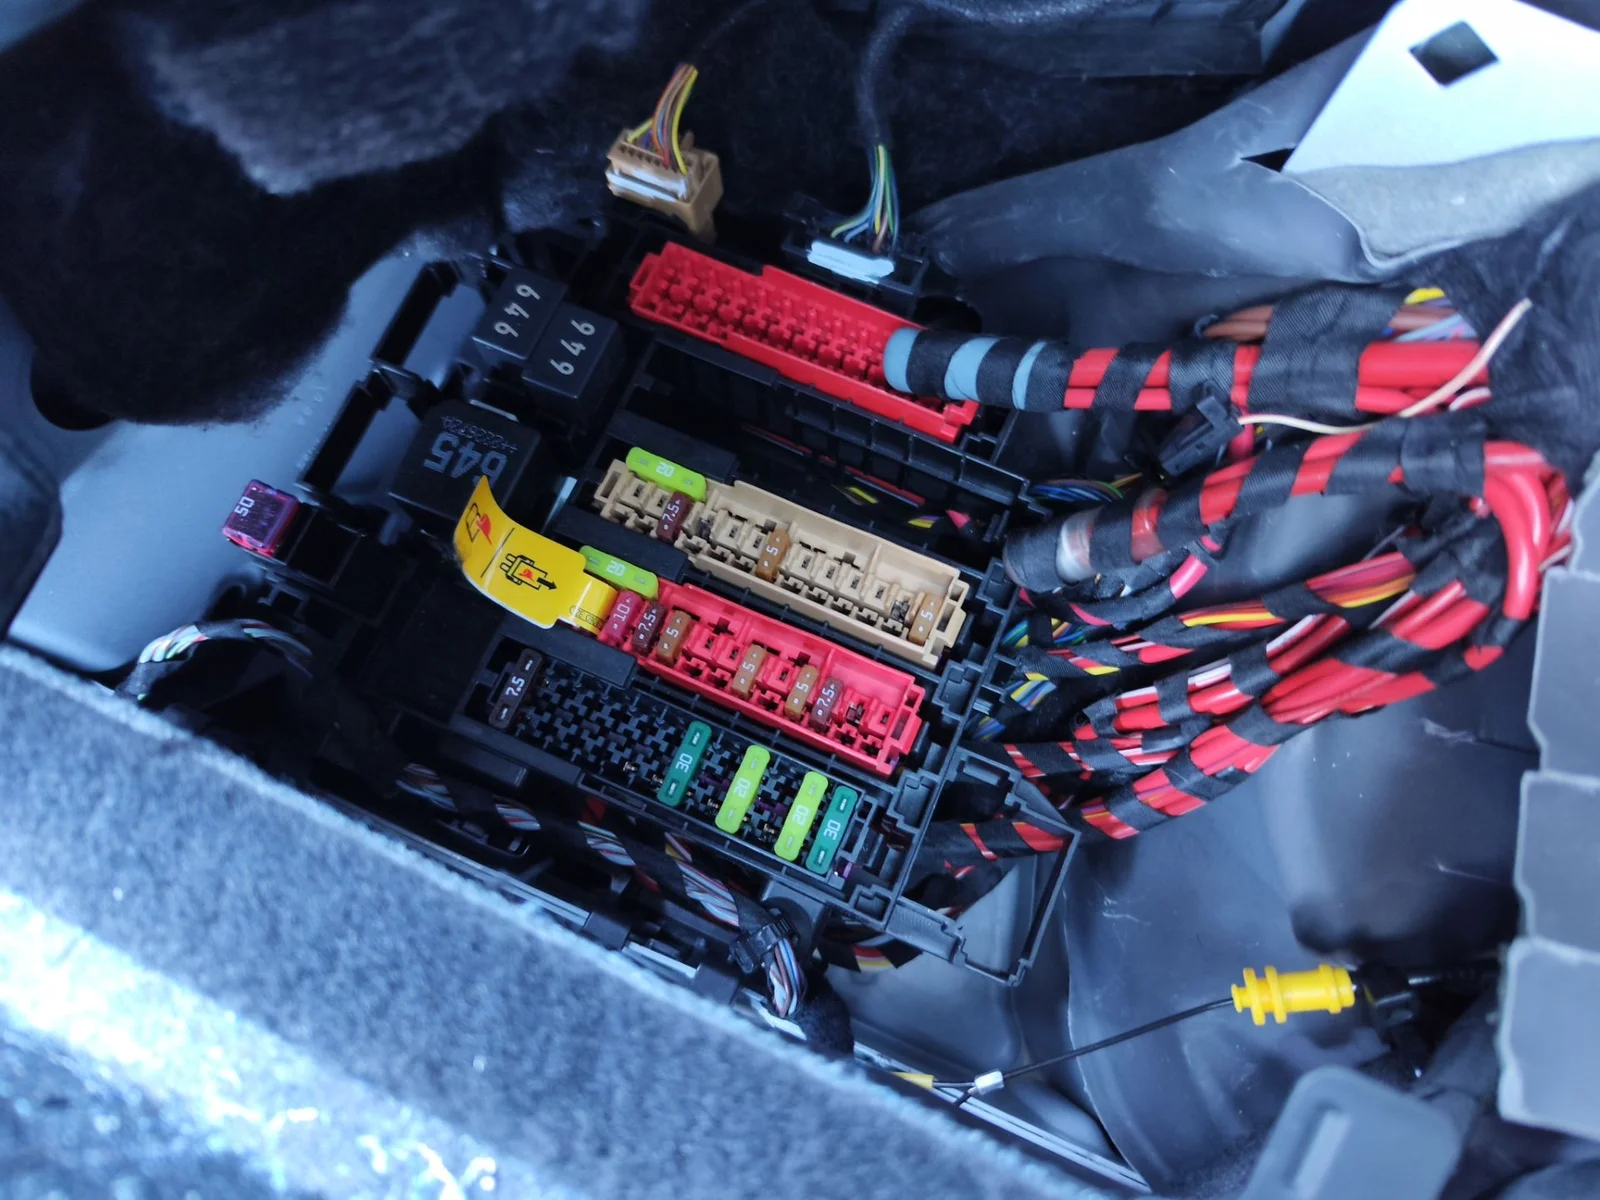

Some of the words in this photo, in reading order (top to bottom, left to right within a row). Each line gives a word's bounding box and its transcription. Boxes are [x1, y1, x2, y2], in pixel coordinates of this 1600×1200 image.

[494, 284, 541, 338] 646
[550, 319, 596, 376] 646
[423, 432, 507, 489] 645
[656, 461, 675, 477] 20
[234, 496, 255, 517] 50
[662, 503, 680, 523] 7.5
[766, 545, 779, 556] 5
[606, 560, 626, 577] 20
[613, 603, 630, 622] 10
[638, 612, 656, 631] 7.5
[920, 610, 933, 621] 5
[666, 627, 679, 638] 5
[742, 661, 755, 673] 5
[505, 676, 525, 696] 7.5
[796, 682, 809, 693] 5
[817, 687, 835, 707] 7.5
[676, 753, 693, 773] 30
[733, 777, 751, 798] 20
[792, 804, 810, 825] 20
[823, 819, 841, 841] 30
